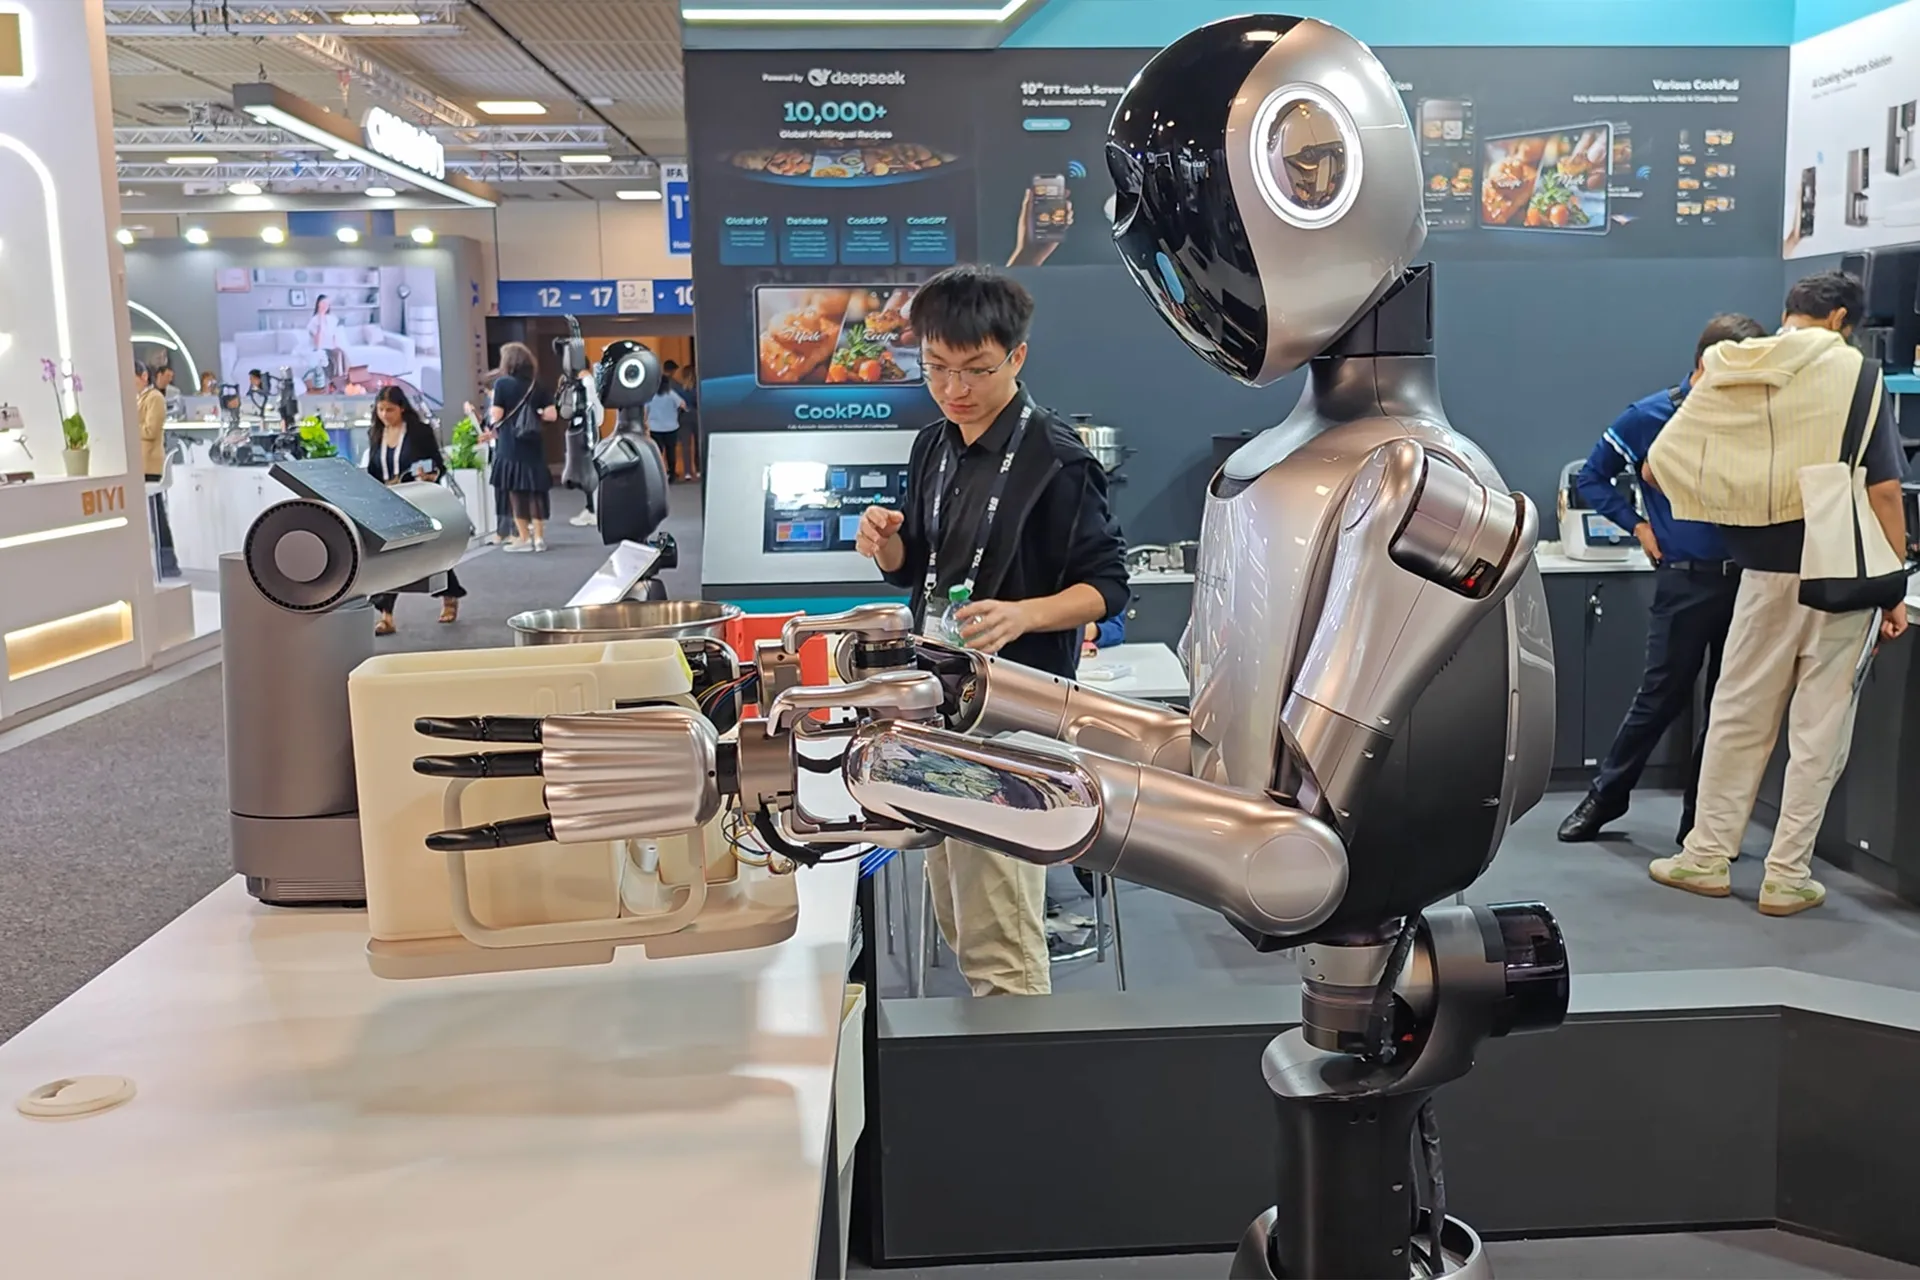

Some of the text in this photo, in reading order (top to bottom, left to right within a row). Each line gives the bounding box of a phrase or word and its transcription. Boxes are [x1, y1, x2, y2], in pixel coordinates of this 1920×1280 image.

[794, 74, 804, 84] by
[830, 71, 905, 87] deepseek
[1653, 79, 1692, 91] Various
[1063, 84, 1092, 95] Touch
[784, 101, 887, 125] 10,000+
[779, 129, 808, 139] Global
[857, 130, 893, 139] Recipes
[666, 168, 684, 177] IFA
[725, 216, 753, 226] Global
[786, 217, 829, 225] Database
[537, 287, 562, 308] 12
[589, 286, 614, 307] 17
[794, 403, 892, 420] CookPAD
[1000, 451, 1015, 474] TCL
[81, 486, 125, 516] BIYI
[972, 547, 984, 569] TCL
